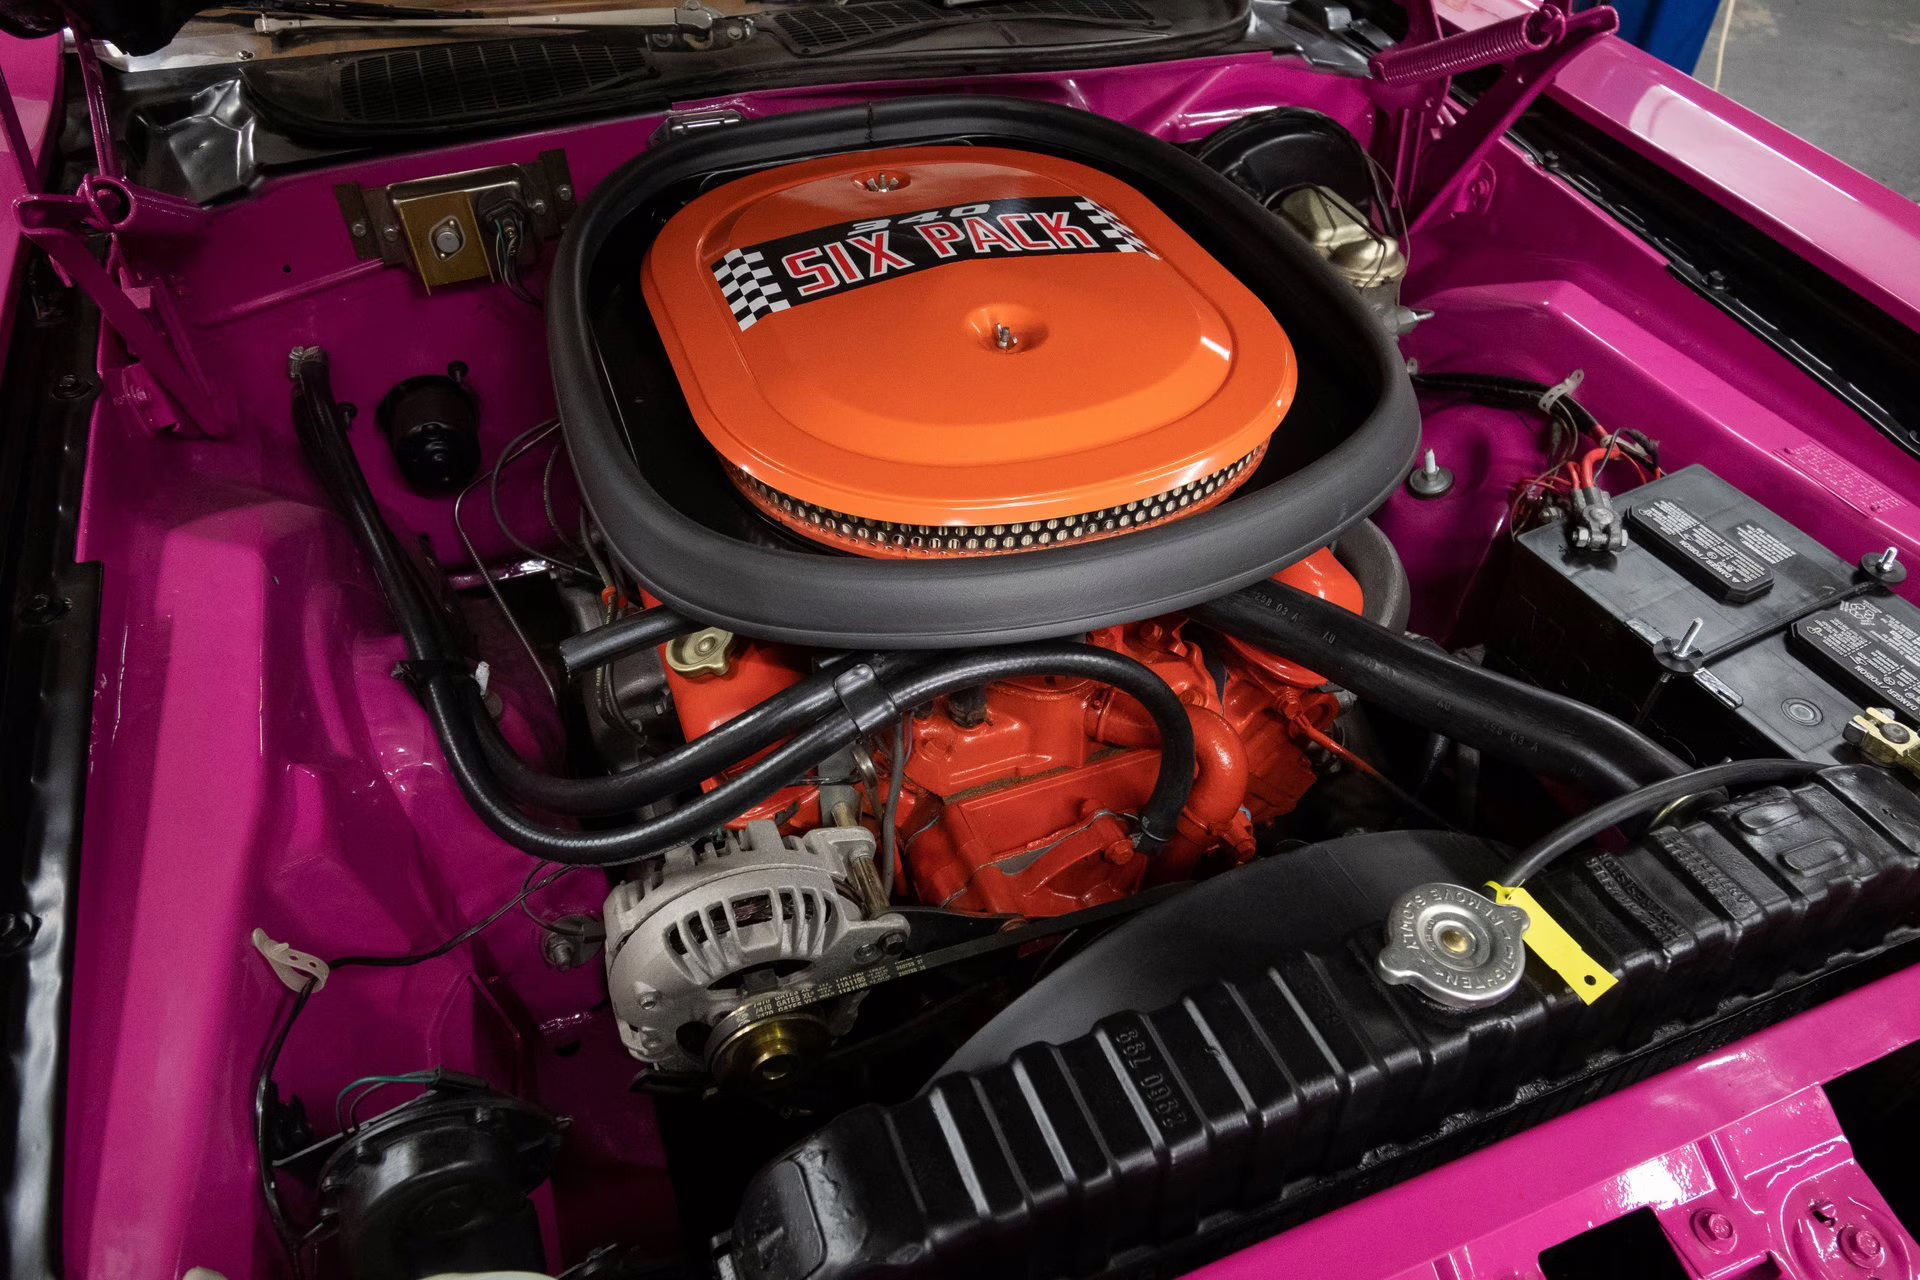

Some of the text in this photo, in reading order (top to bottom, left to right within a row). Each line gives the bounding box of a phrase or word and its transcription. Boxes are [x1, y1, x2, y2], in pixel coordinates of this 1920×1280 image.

[847, 203, 991, 236] 340
[781, 212, 1097, 297] SIX PACK
[1679, 540, 1703, 558] POISON
[1705, 560, 1732, 578] DANGER
[1854, 665, 1883, 686] POISON
[1886, 688, 1918, 711] DANGER
[1399, 888, 1505, 951] REMOVE SLOWLY
[1445, 960, 1515, 989] TIGHTEN
[776, 996, 801, 1008] GATES
